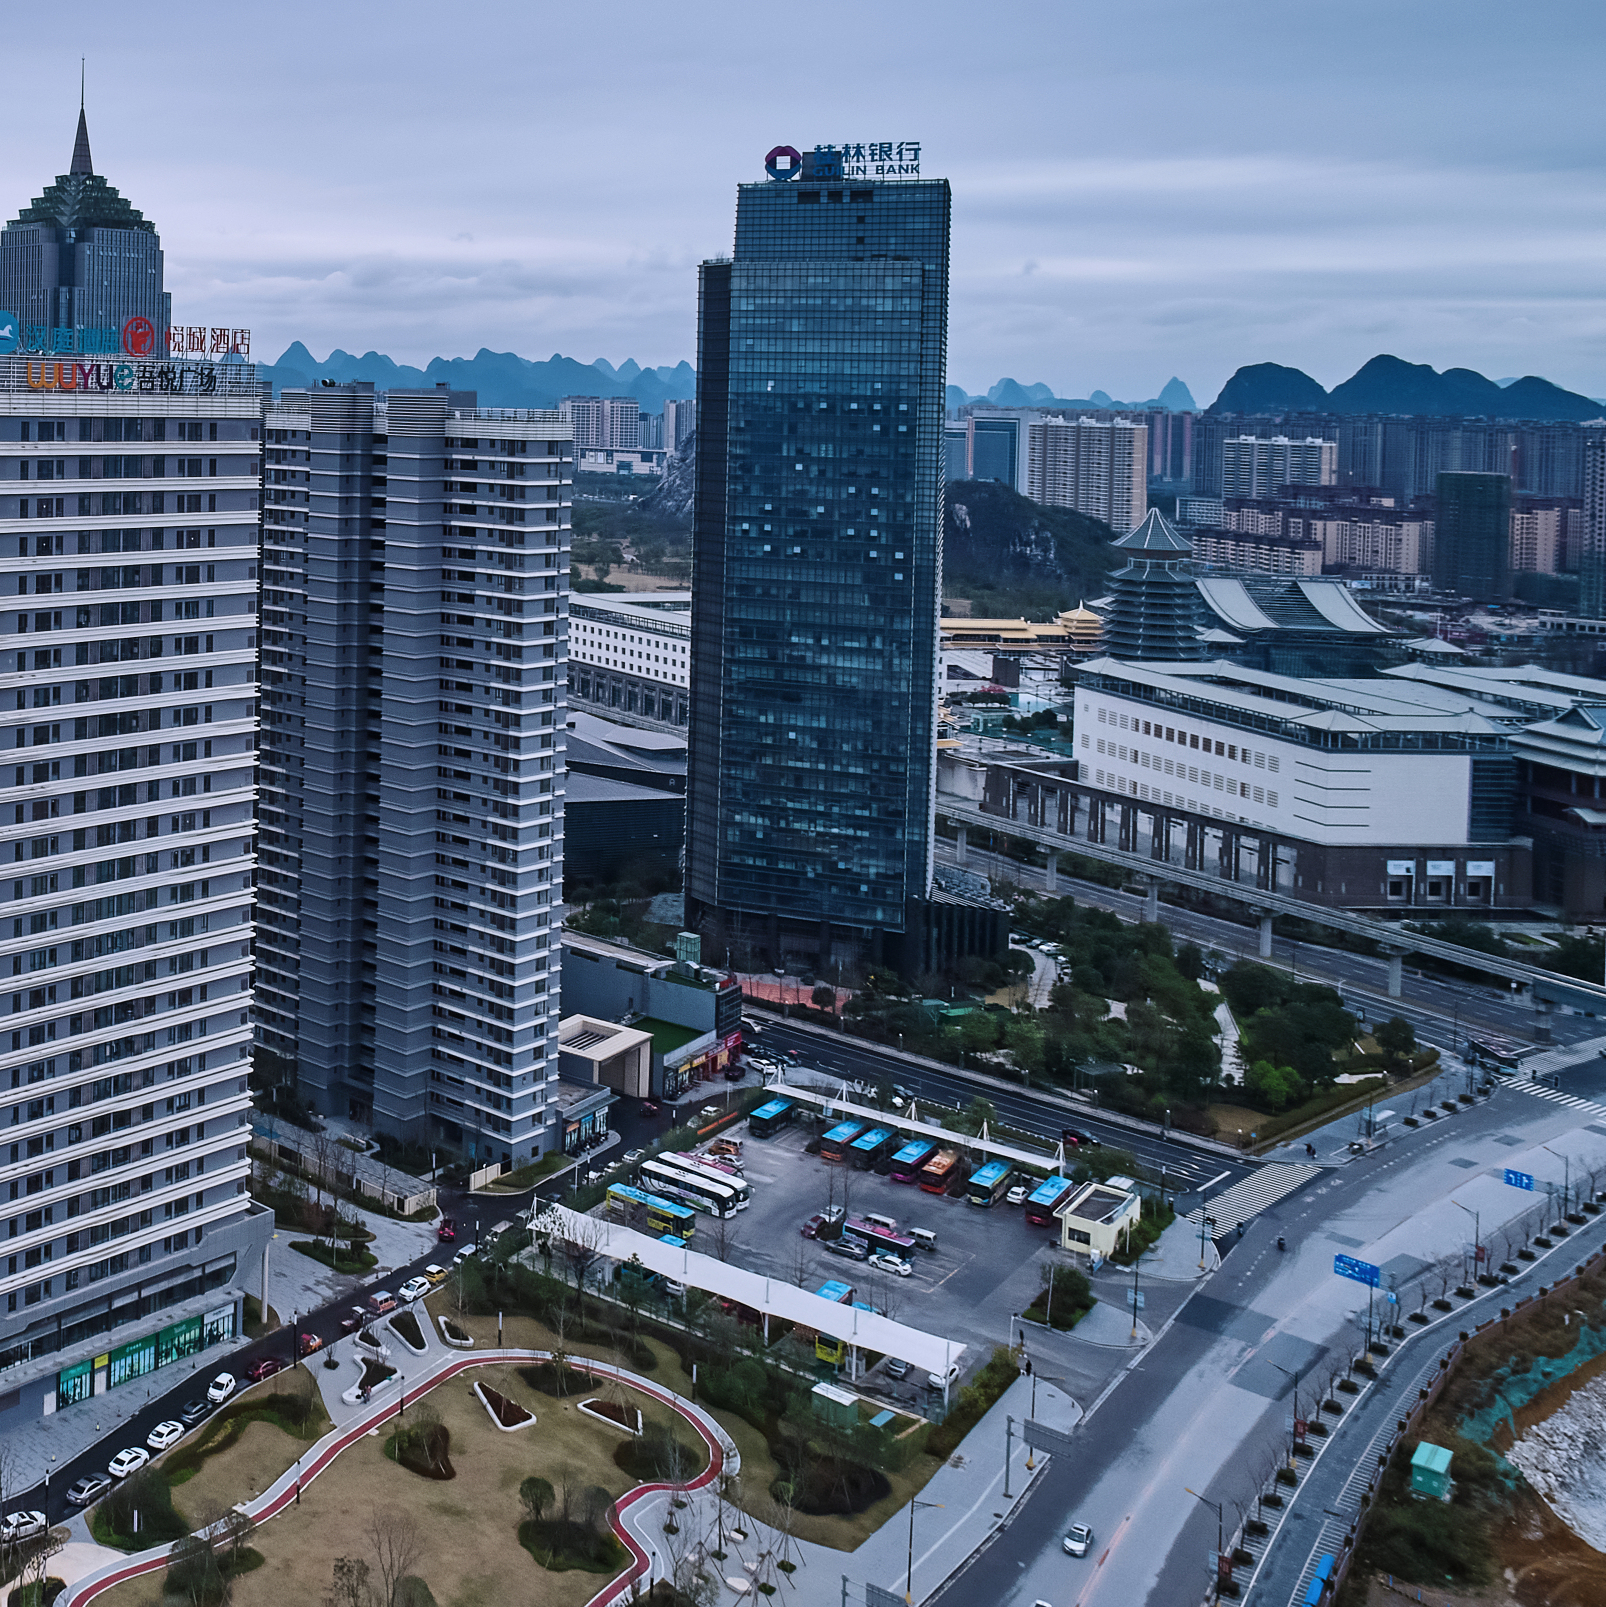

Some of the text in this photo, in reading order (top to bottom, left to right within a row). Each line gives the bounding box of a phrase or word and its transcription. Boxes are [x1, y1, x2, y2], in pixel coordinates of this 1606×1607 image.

[813, 141, 922, 165] 桂林银行
[812, 163, 920, 177] GUILIN BANK
[165, 326, 251, 354] 悦城酒店
[138, 364, 217, 393] 吾悦广场
